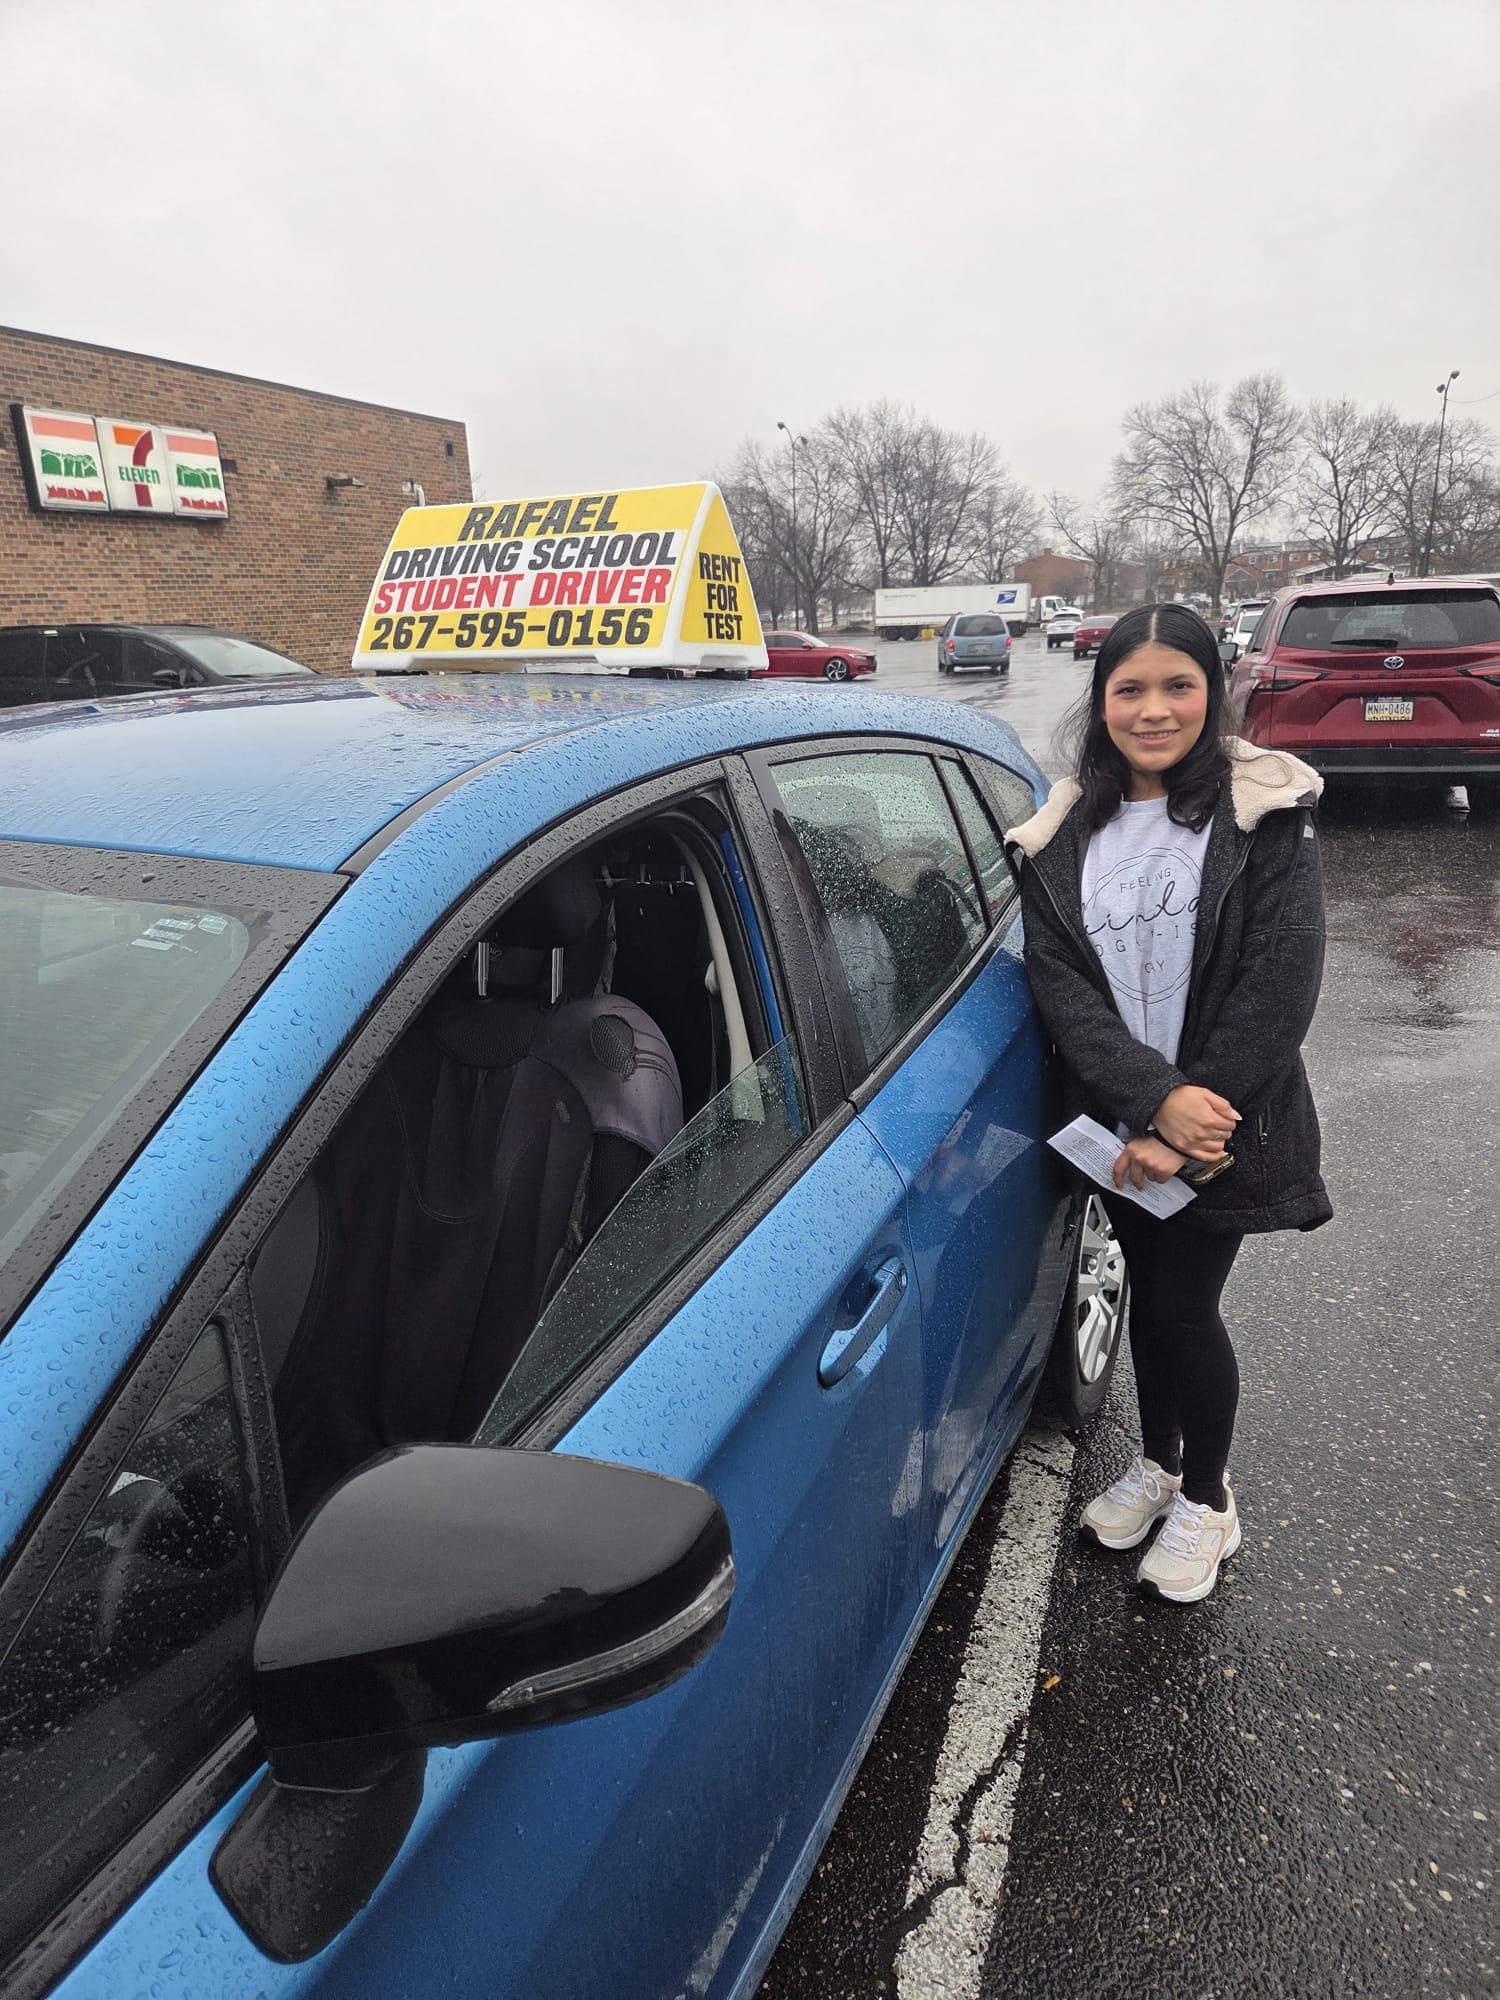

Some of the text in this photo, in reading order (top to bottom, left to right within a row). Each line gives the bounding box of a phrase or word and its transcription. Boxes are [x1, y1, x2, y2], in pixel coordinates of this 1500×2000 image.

[118, 466, 161, 485] ELEVEn
[457, 495, 619, 542] RAFAEL
[383, 531, 677, 581] DRIVING SCHOOL
[698, 552, 741, 584] RENT
[374, 568, 672, 614] STUDENT DRIVER
[707, 583, 739, 612] FOR
[370, 608, 653, 650] 267-595-0156
[703, 612, 743, 641] TEST
